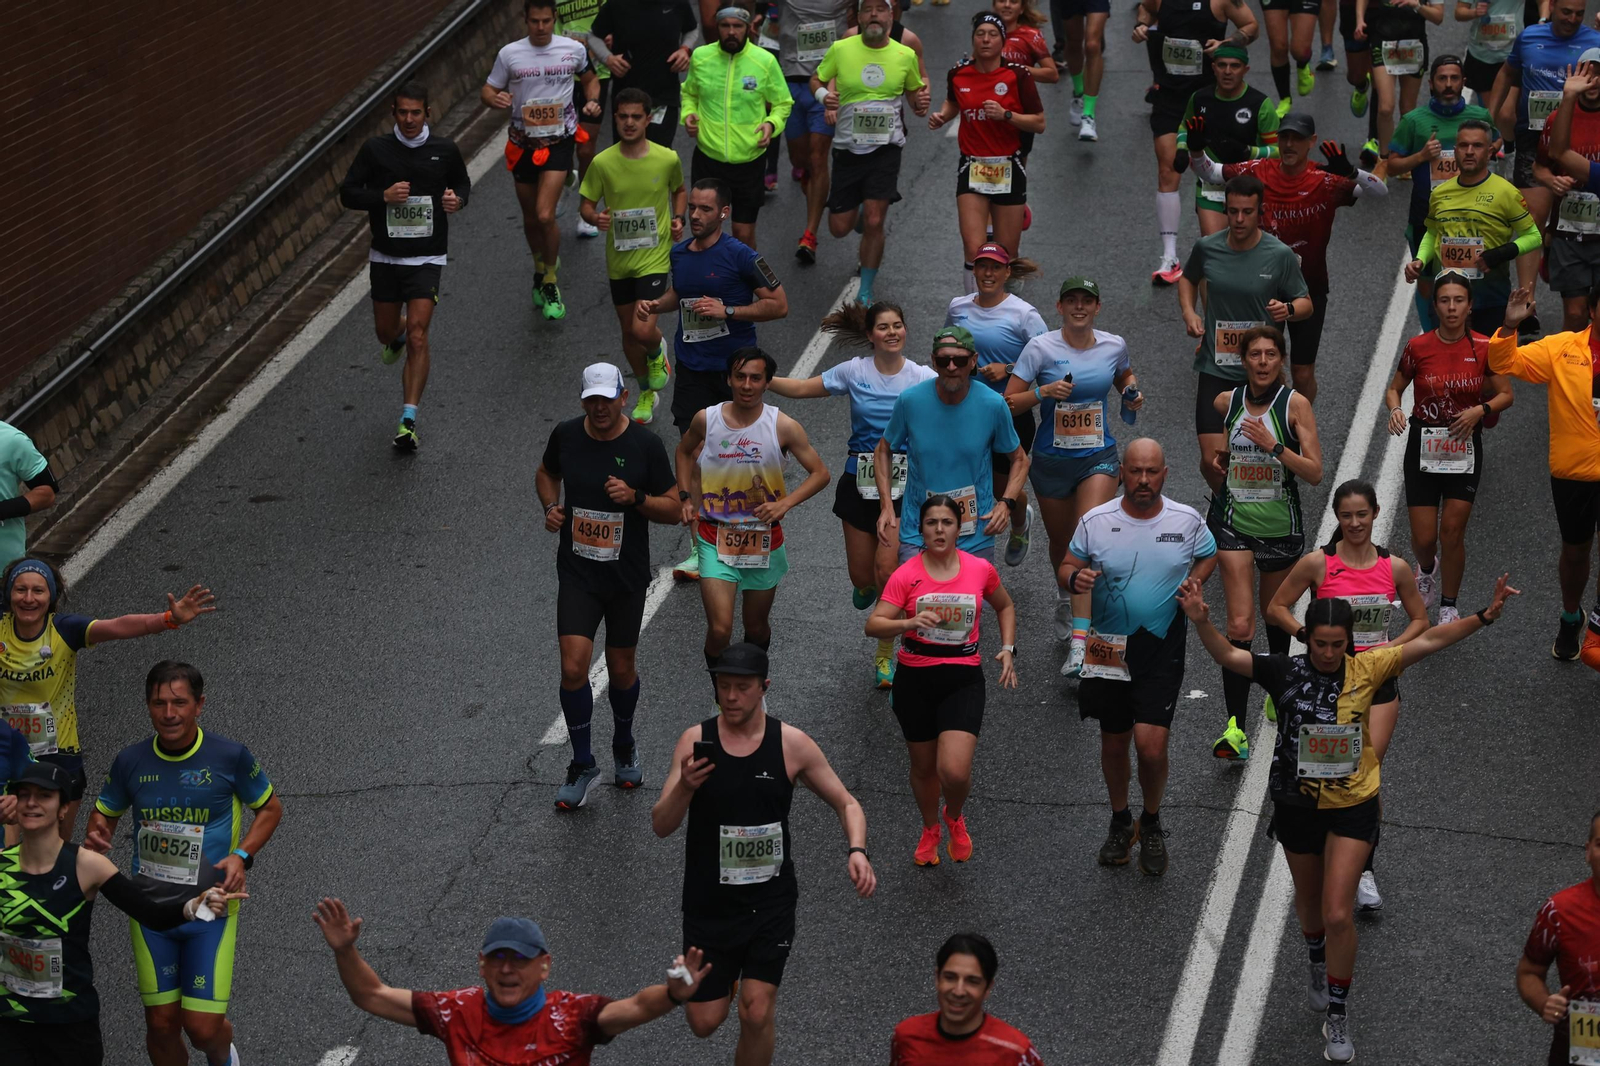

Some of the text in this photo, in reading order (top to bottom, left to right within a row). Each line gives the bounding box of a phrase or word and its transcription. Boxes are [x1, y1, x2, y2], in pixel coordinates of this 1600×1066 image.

[802, 31, 828, 45] 7568
[1167, 48, 1193, 60] 7542
[528, 107, 555, 121] 4953
[858, 115, 886, 129] 7572
[973, 165, 1005, 178] 14541
[394, 206, 424, 220] 8064
[1566, 201, 1593, 216] 7371
[618, 218, 647, 233] 7794
[1445, 247, 1473, 261] 4924
[1421, 401, 1439, 421] 30
[1062, 413, 1092, 428] 6316
[1231, 442, 1268, 454] Trent Pa
[1425, 438, 1467, 453] 17404
[1232, 465, 1274, 482] 10280
[577, 521, 611, 541] 4340
[725, 532, 758, 548] 5941
[1353, 607, 1382, 624] 047
[1089, 642, 1115, 660] 4657
[0, 665, 55, 682] ALEARIA
[1308, 737, 1350, 756] 9575
[140, 806, 210, 824] TUSSAM
[725, 838, 774, 859] 10288
